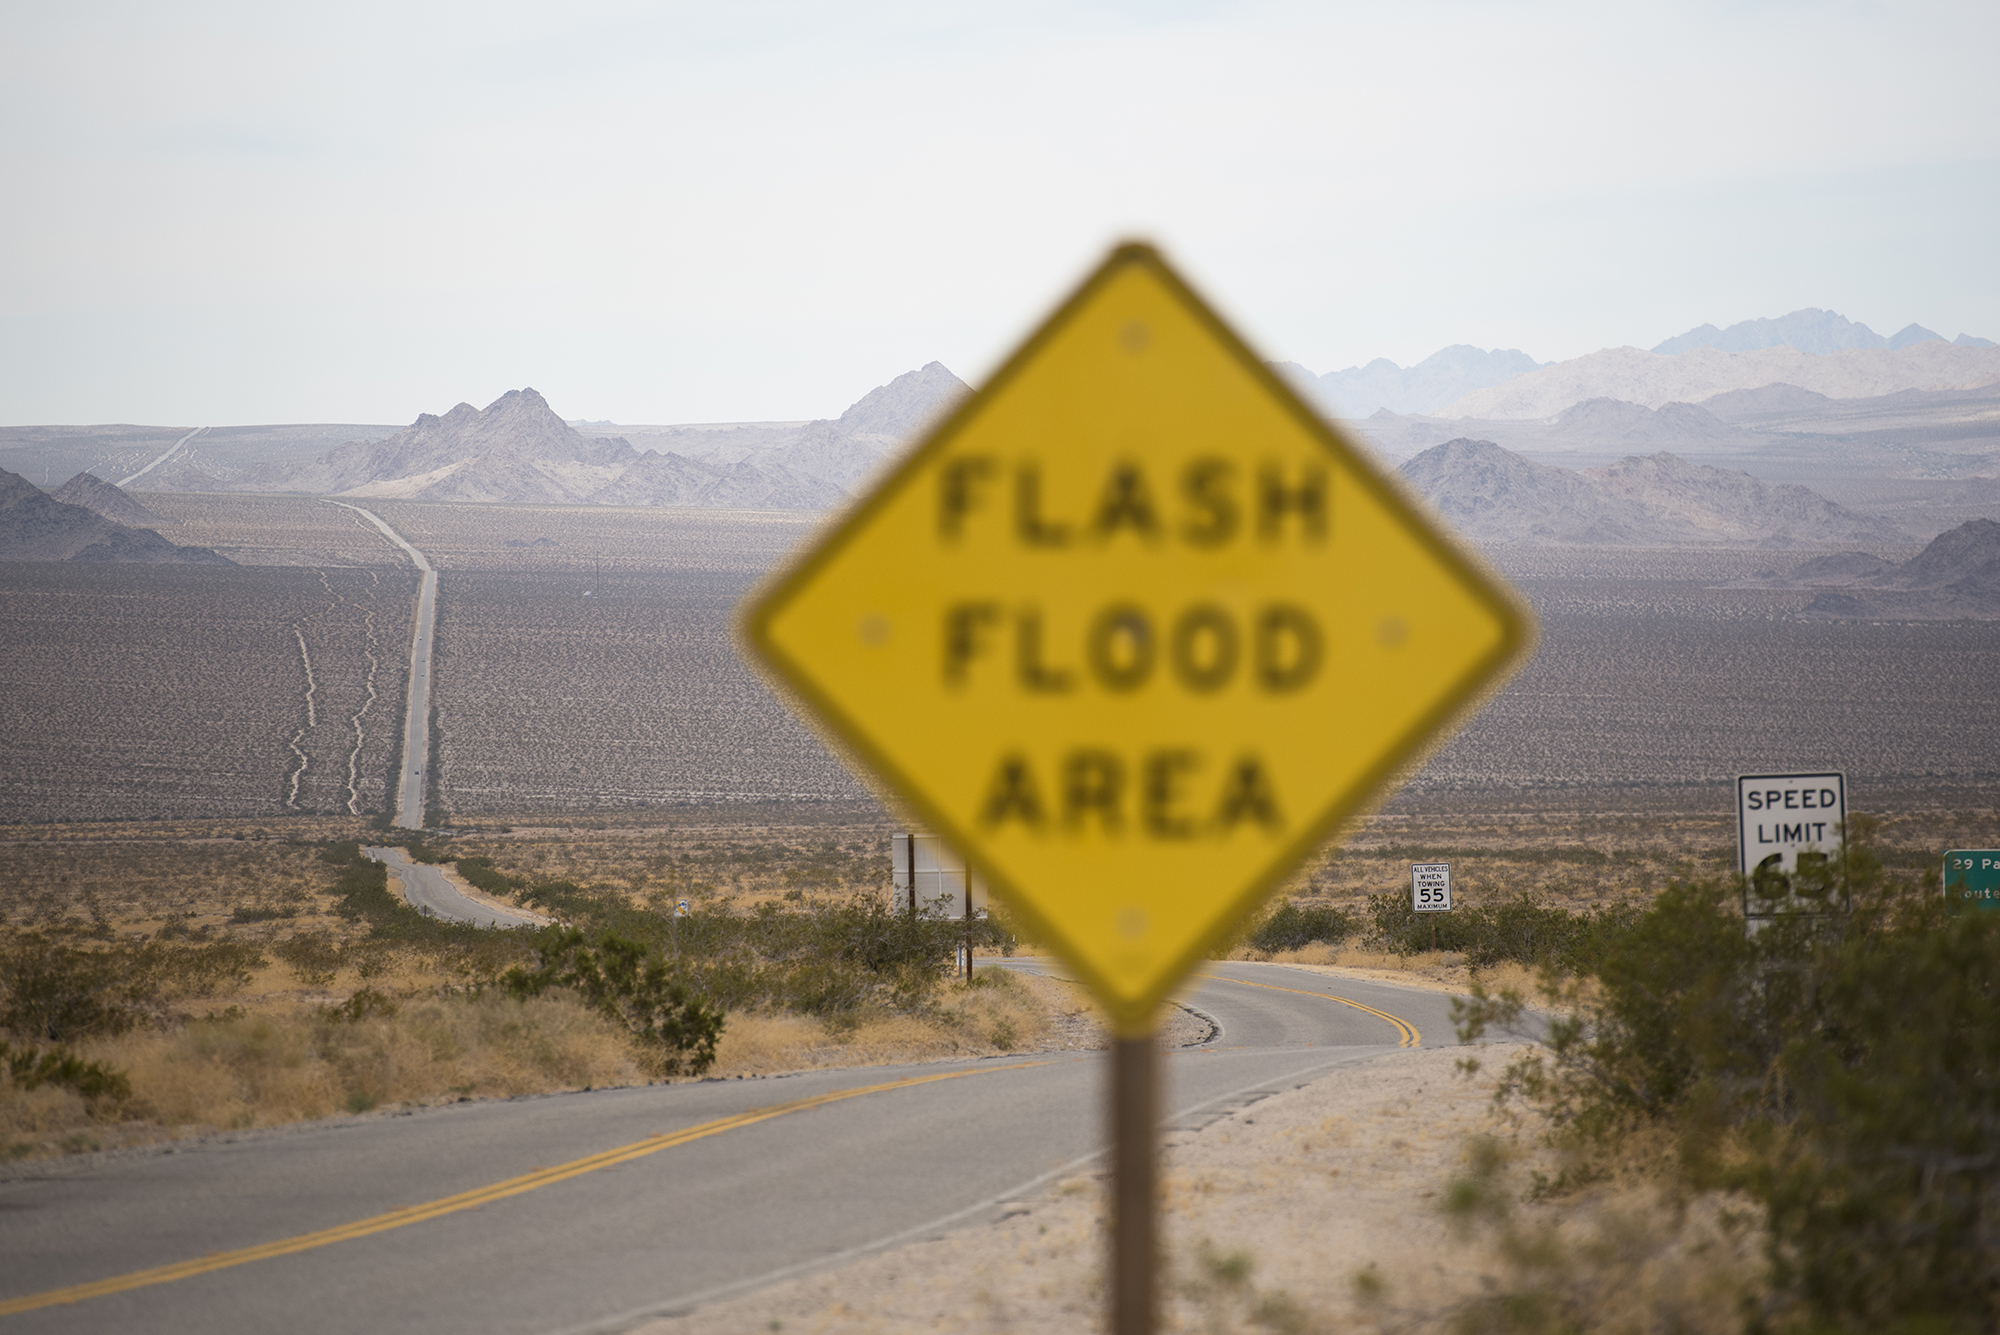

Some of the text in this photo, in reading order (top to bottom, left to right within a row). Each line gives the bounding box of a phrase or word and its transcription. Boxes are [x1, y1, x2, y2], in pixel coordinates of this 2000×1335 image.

[937, 455, 1330, 552] FLASH
[940, 601, 1326, 696] FLOOD
[975, 746, 1284, 843] AREA
[1748, 789, 1836, 810] SPEED
[1758, 823, 1827, 843] LIMIT
[1953, 858, 1973, 870] 29
[1420, 888, 1444, 902] 55
[1955, 887, 2000, 899] oute
